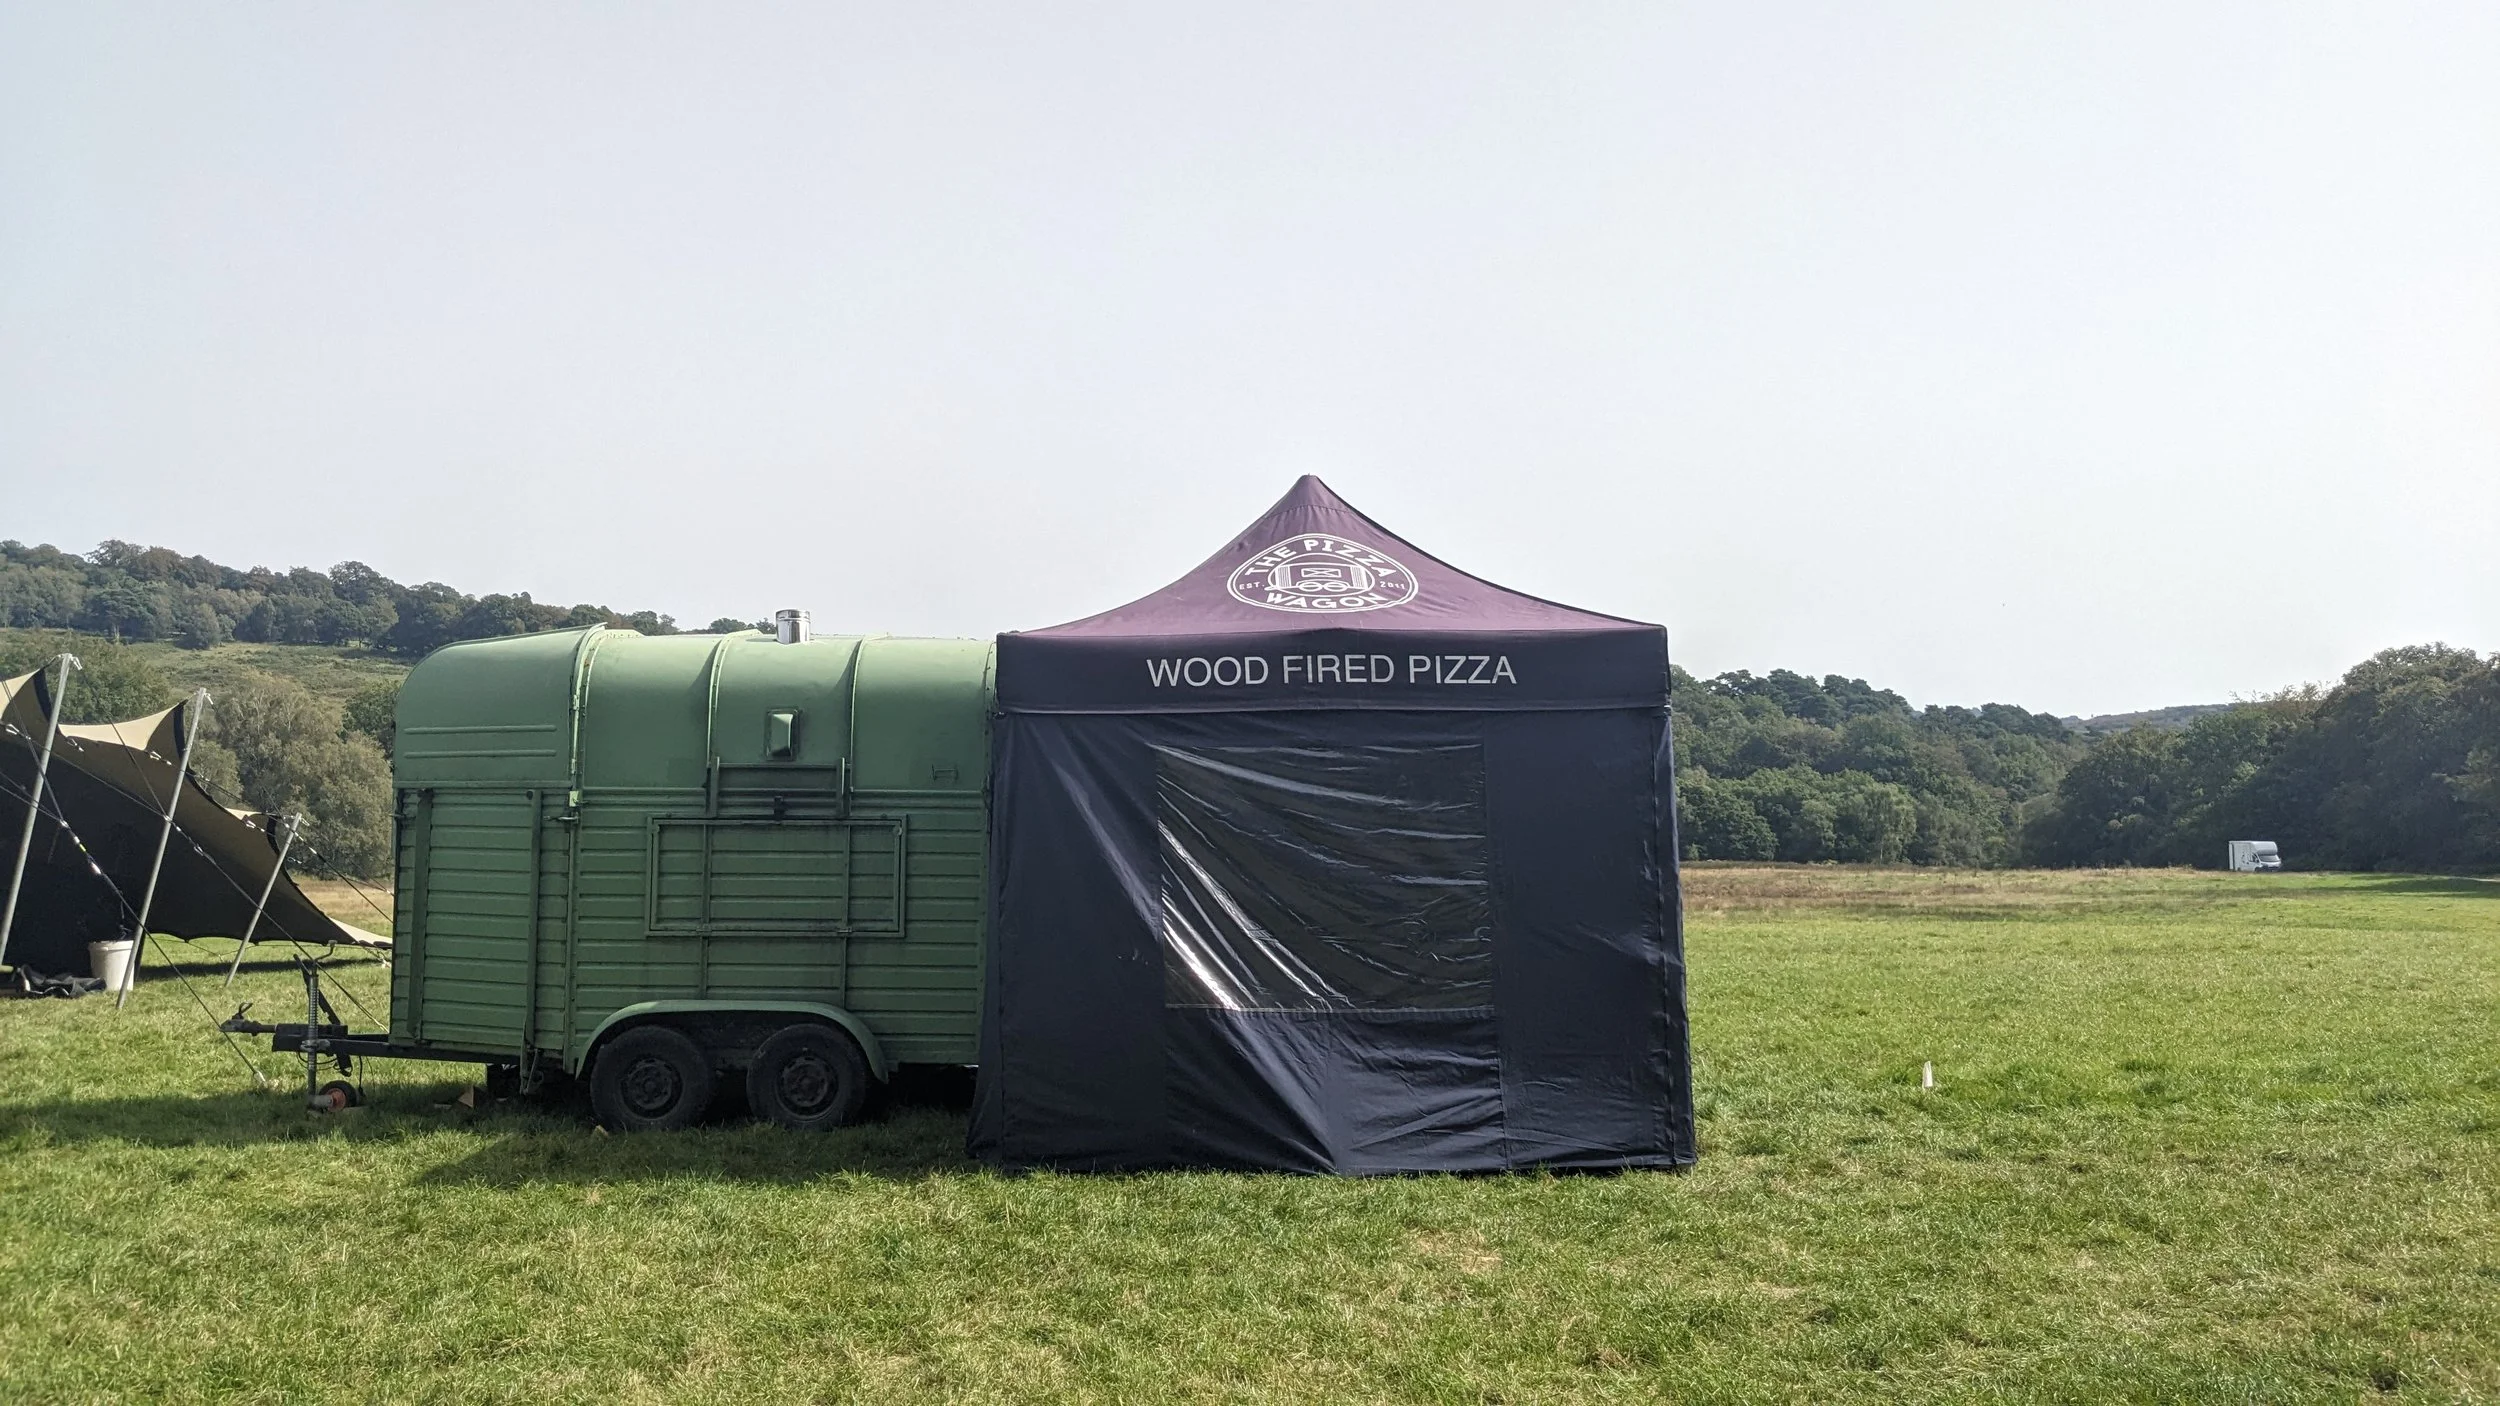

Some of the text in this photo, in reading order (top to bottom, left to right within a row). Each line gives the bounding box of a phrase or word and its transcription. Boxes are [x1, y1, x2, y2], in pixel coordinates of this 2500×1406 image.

[1245, 539, 1396, 577] THE PIZZA
[1379, 581, 1406, 590] 2011
[1266, 592, 1389, 608] WAGON
[1146, 654, 1517, 687] WOOD FIRED PIZZA
